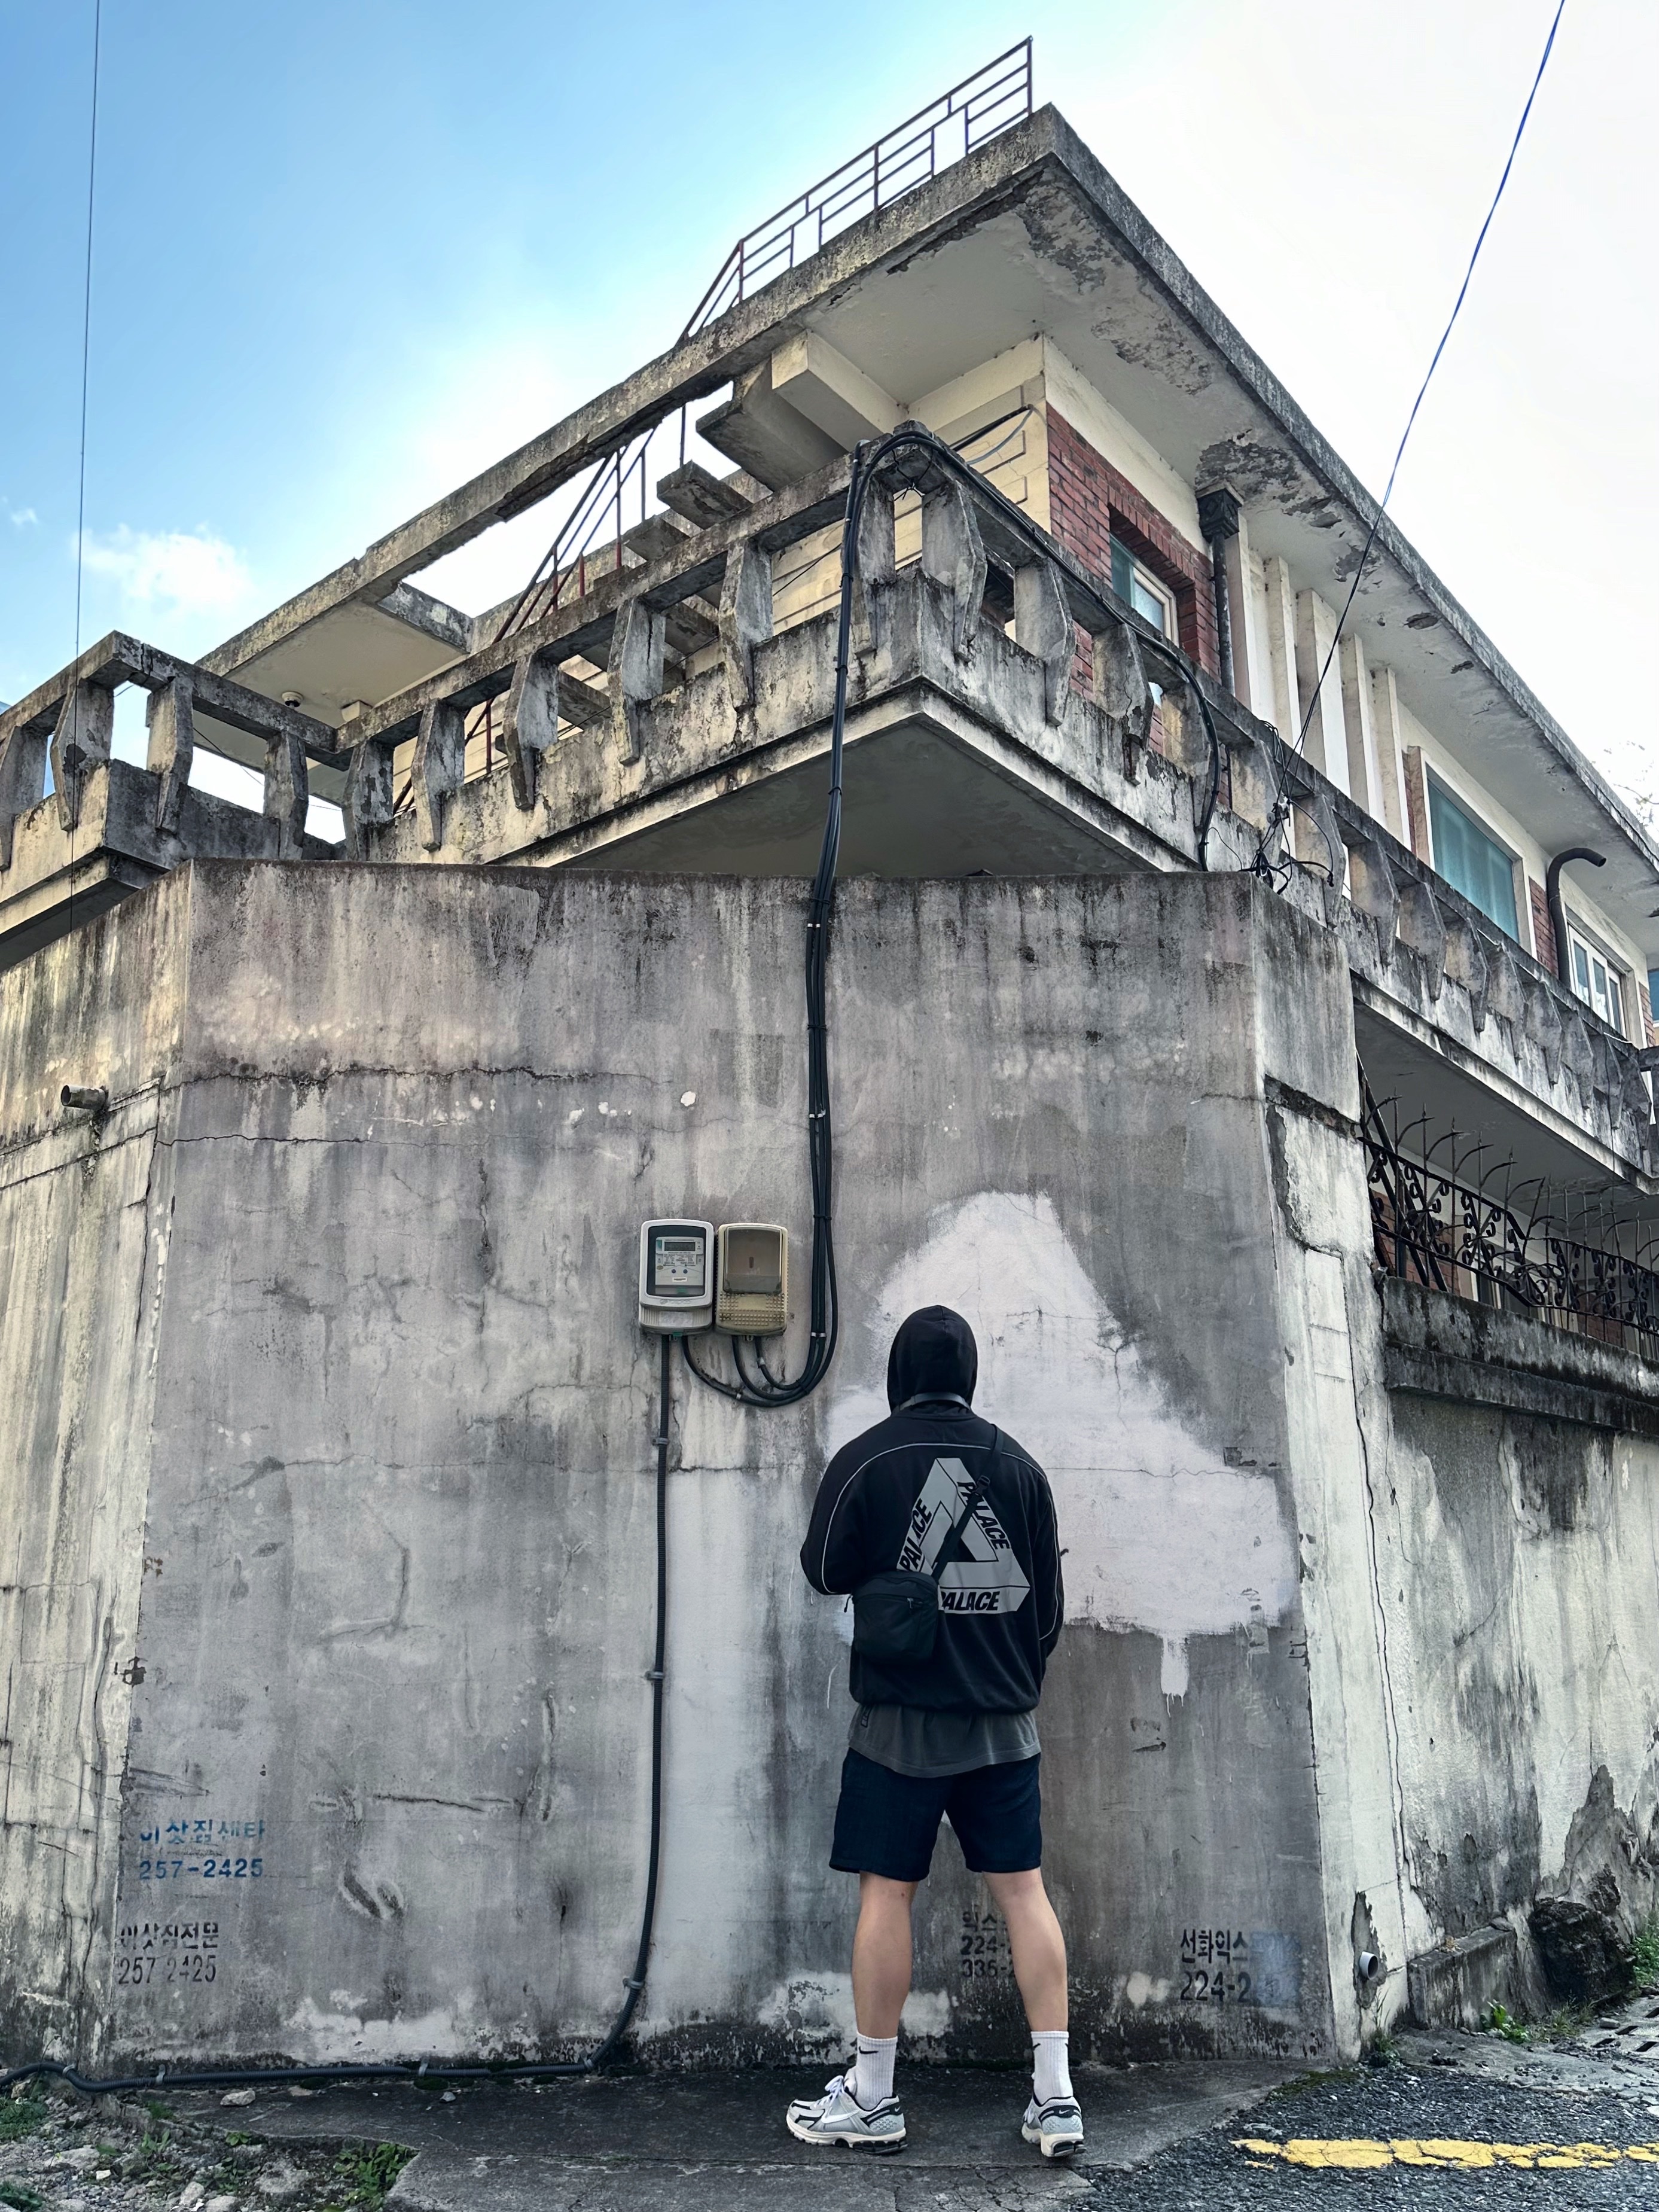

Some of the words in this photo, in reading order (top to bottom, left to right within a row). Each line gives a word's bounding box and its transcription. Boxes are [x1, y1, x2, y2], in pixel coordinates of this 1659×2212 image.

[139, 1858, 263, 1879] 257-2425
[962, 1912, 1008, 1932] 익스
[120, 1921, 219, 1950] 이삿짐전문
[960, 1936, 1012, 1955] 224-
[962, 1959, 1015, 1978] 336-
